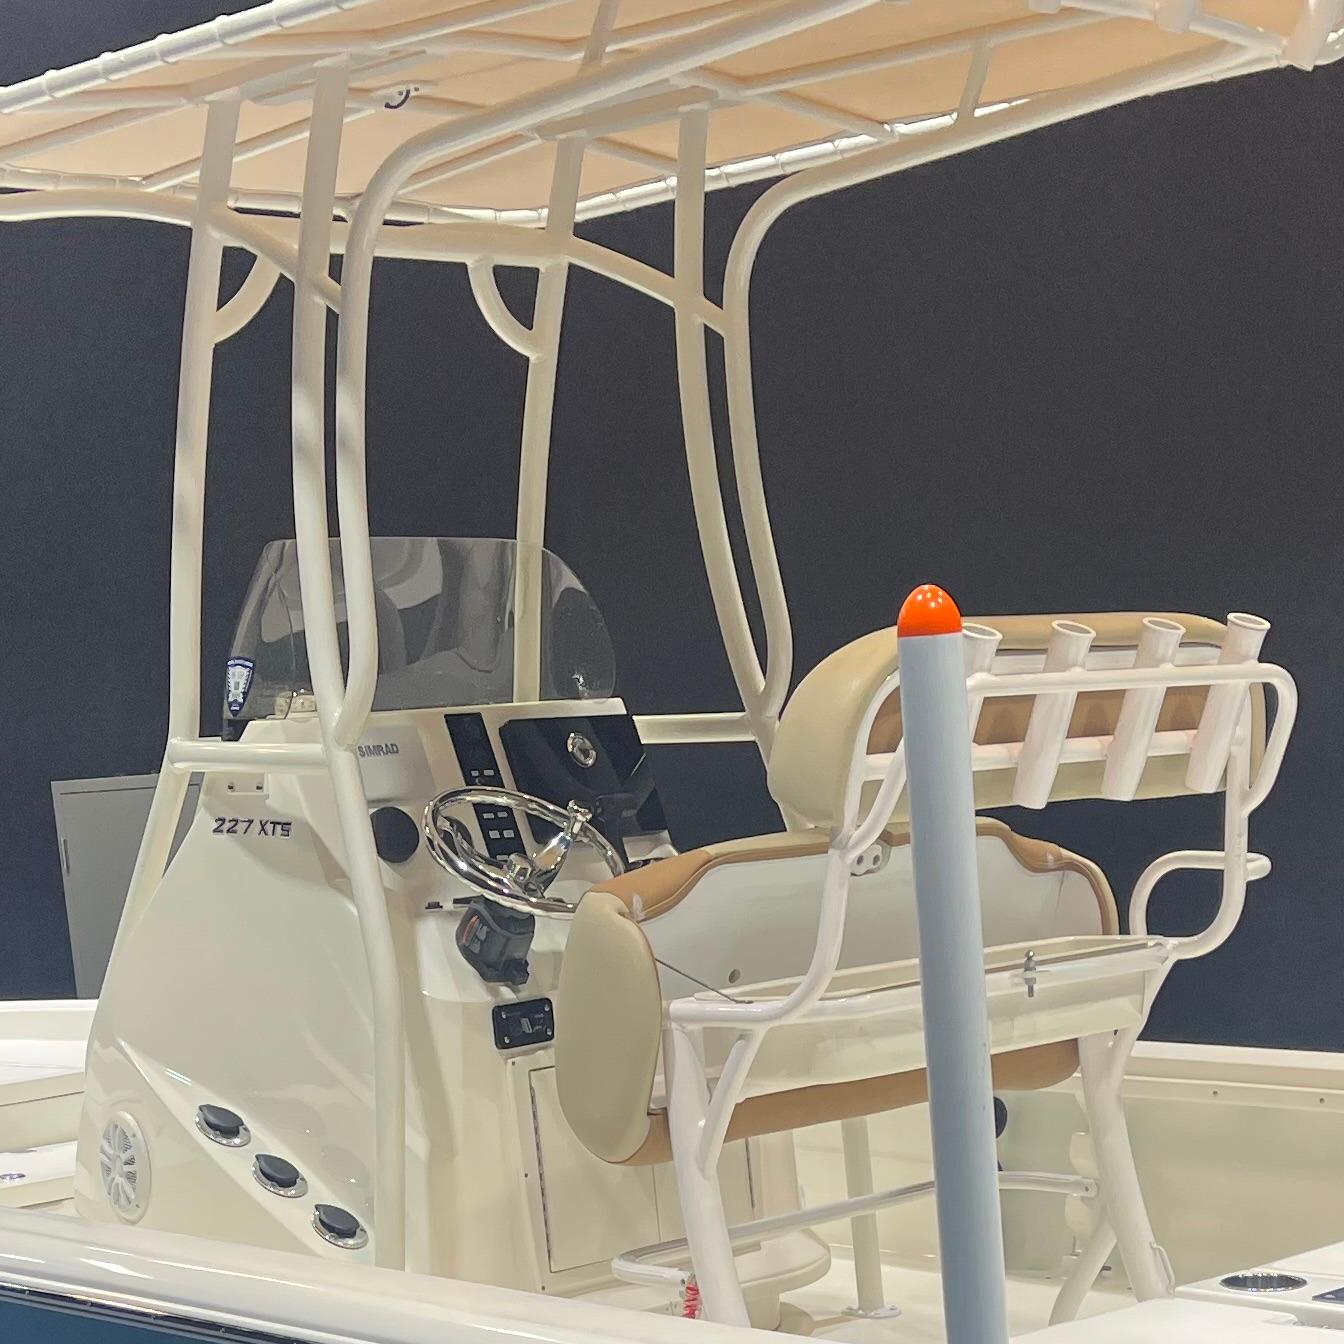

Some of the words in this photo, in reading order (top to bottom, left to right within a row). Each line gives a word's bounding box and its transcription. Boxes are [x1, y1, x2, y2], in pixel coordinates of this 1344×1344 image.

[357, 743, 400, 758] SIMRAD
[212, 816, 254, 835] 227
[258, 819, 293, 838] XTS
